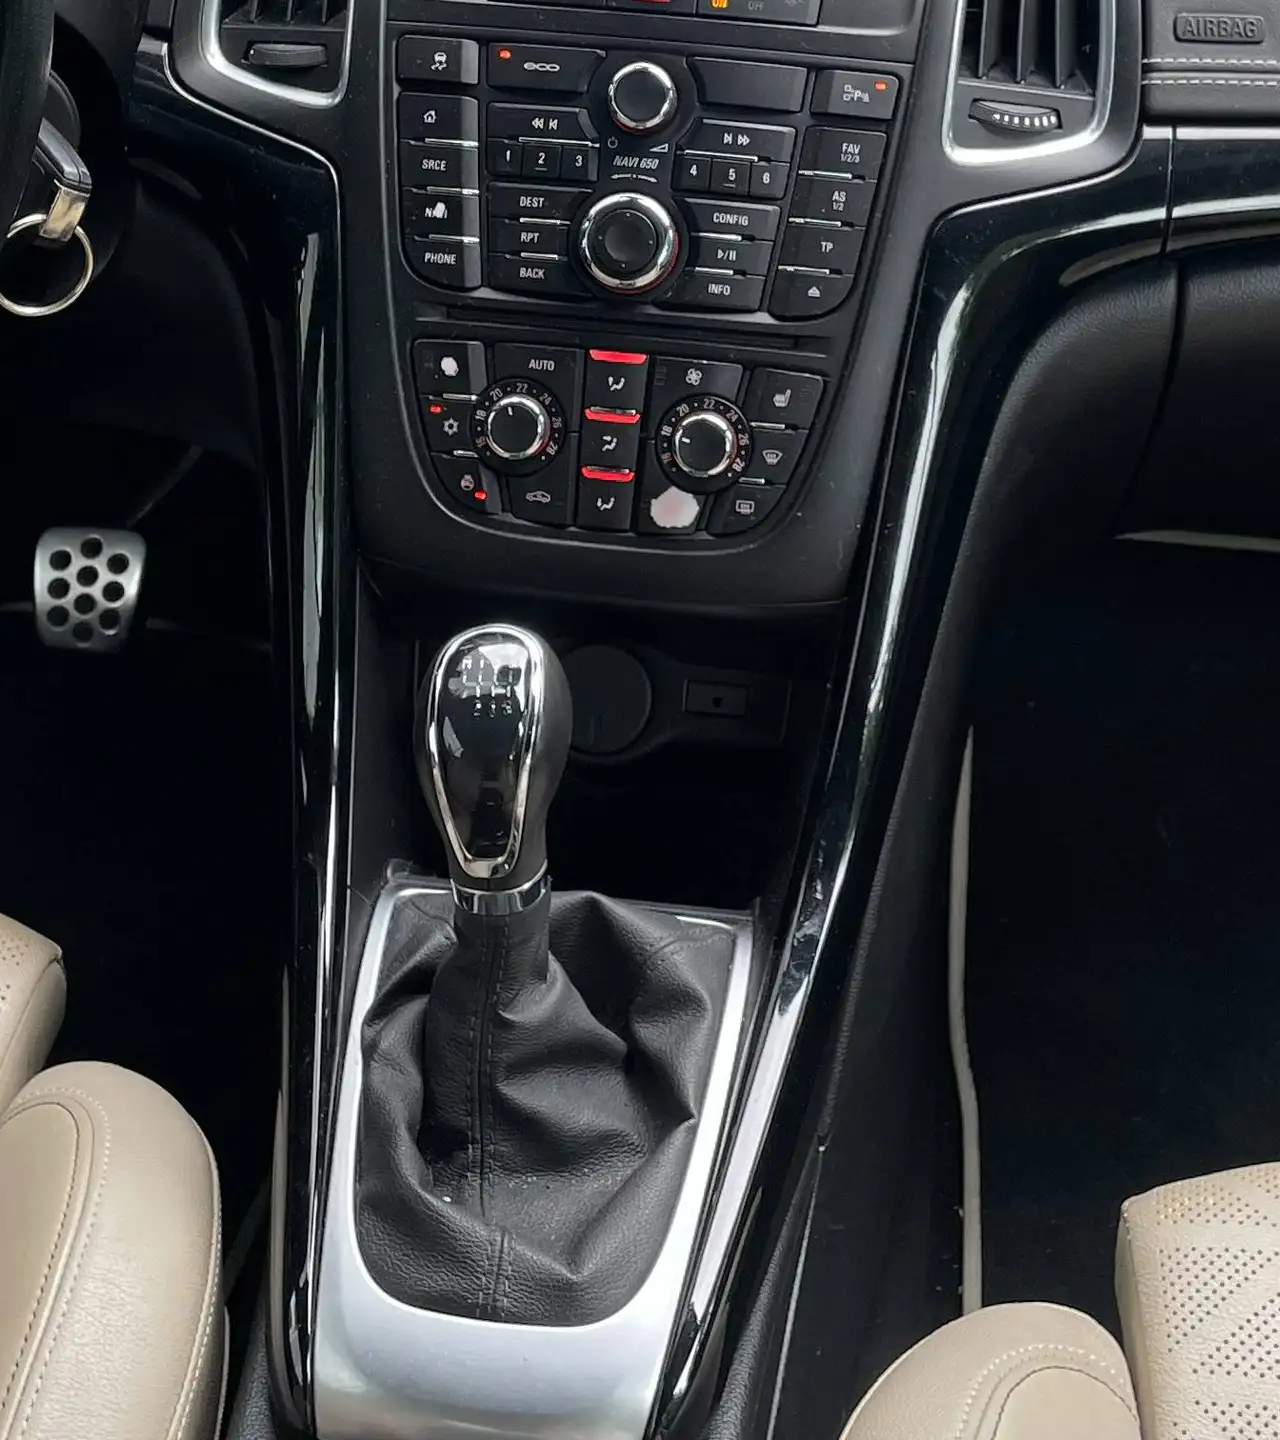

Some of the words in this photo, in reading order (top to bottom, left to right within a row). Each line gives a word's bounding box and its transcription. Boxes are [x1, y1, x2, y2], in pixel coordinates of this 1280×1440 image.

[748, 1, 765, 11] OFF
[1182, 17, 1259, 39] AIRBAG
[842, 142, 861, 154] FAV
[505, 150, 511, 162] 1
[537, 152, 546, 164] 2
[575, 155, 583, 167] 3
[841, 154, 861, 164] 1/2/3
[421, 159, 447, 171] SRCE
[613, 155, 640, 168] NAVI
[640, 158, 660, 170] 650
[690, 164, 698, 176] 4
[728, 168, 736, 180] 5
[762, 172, 771, 184] 6
[519, 196, 545, 208] DEST
[832, 191, 846, 202] AS
[424, 206, 448, 219] NI
[832, 201, 845, 212] 1/2
[713, 212, 749, 226] CONFIG
[520, 231, 540, 244] RPT
[821, 241, 835, 253] TP
[424, 251, 457, 265] PHONE
[519, 267, 545, 280] BACK
[708, 283, 731, 296] INFO
[528, 359, 555, 372] AUTO
[516, 382, 529, 393] 22
[489, 387, 504, 401] 20
[539, 393, 552, 406] 24
[703, 398, 716, 409] 22
[475, 409, 487, 421] 18
[676, 403, 690, 417] 20
[725, 410, 739, 423] 24
[660, 425, 673, 437] 18
[738, 433, 750, 446] 26
[546, 441, 559, 456] 28
[731, 458, 746, 473] 28
